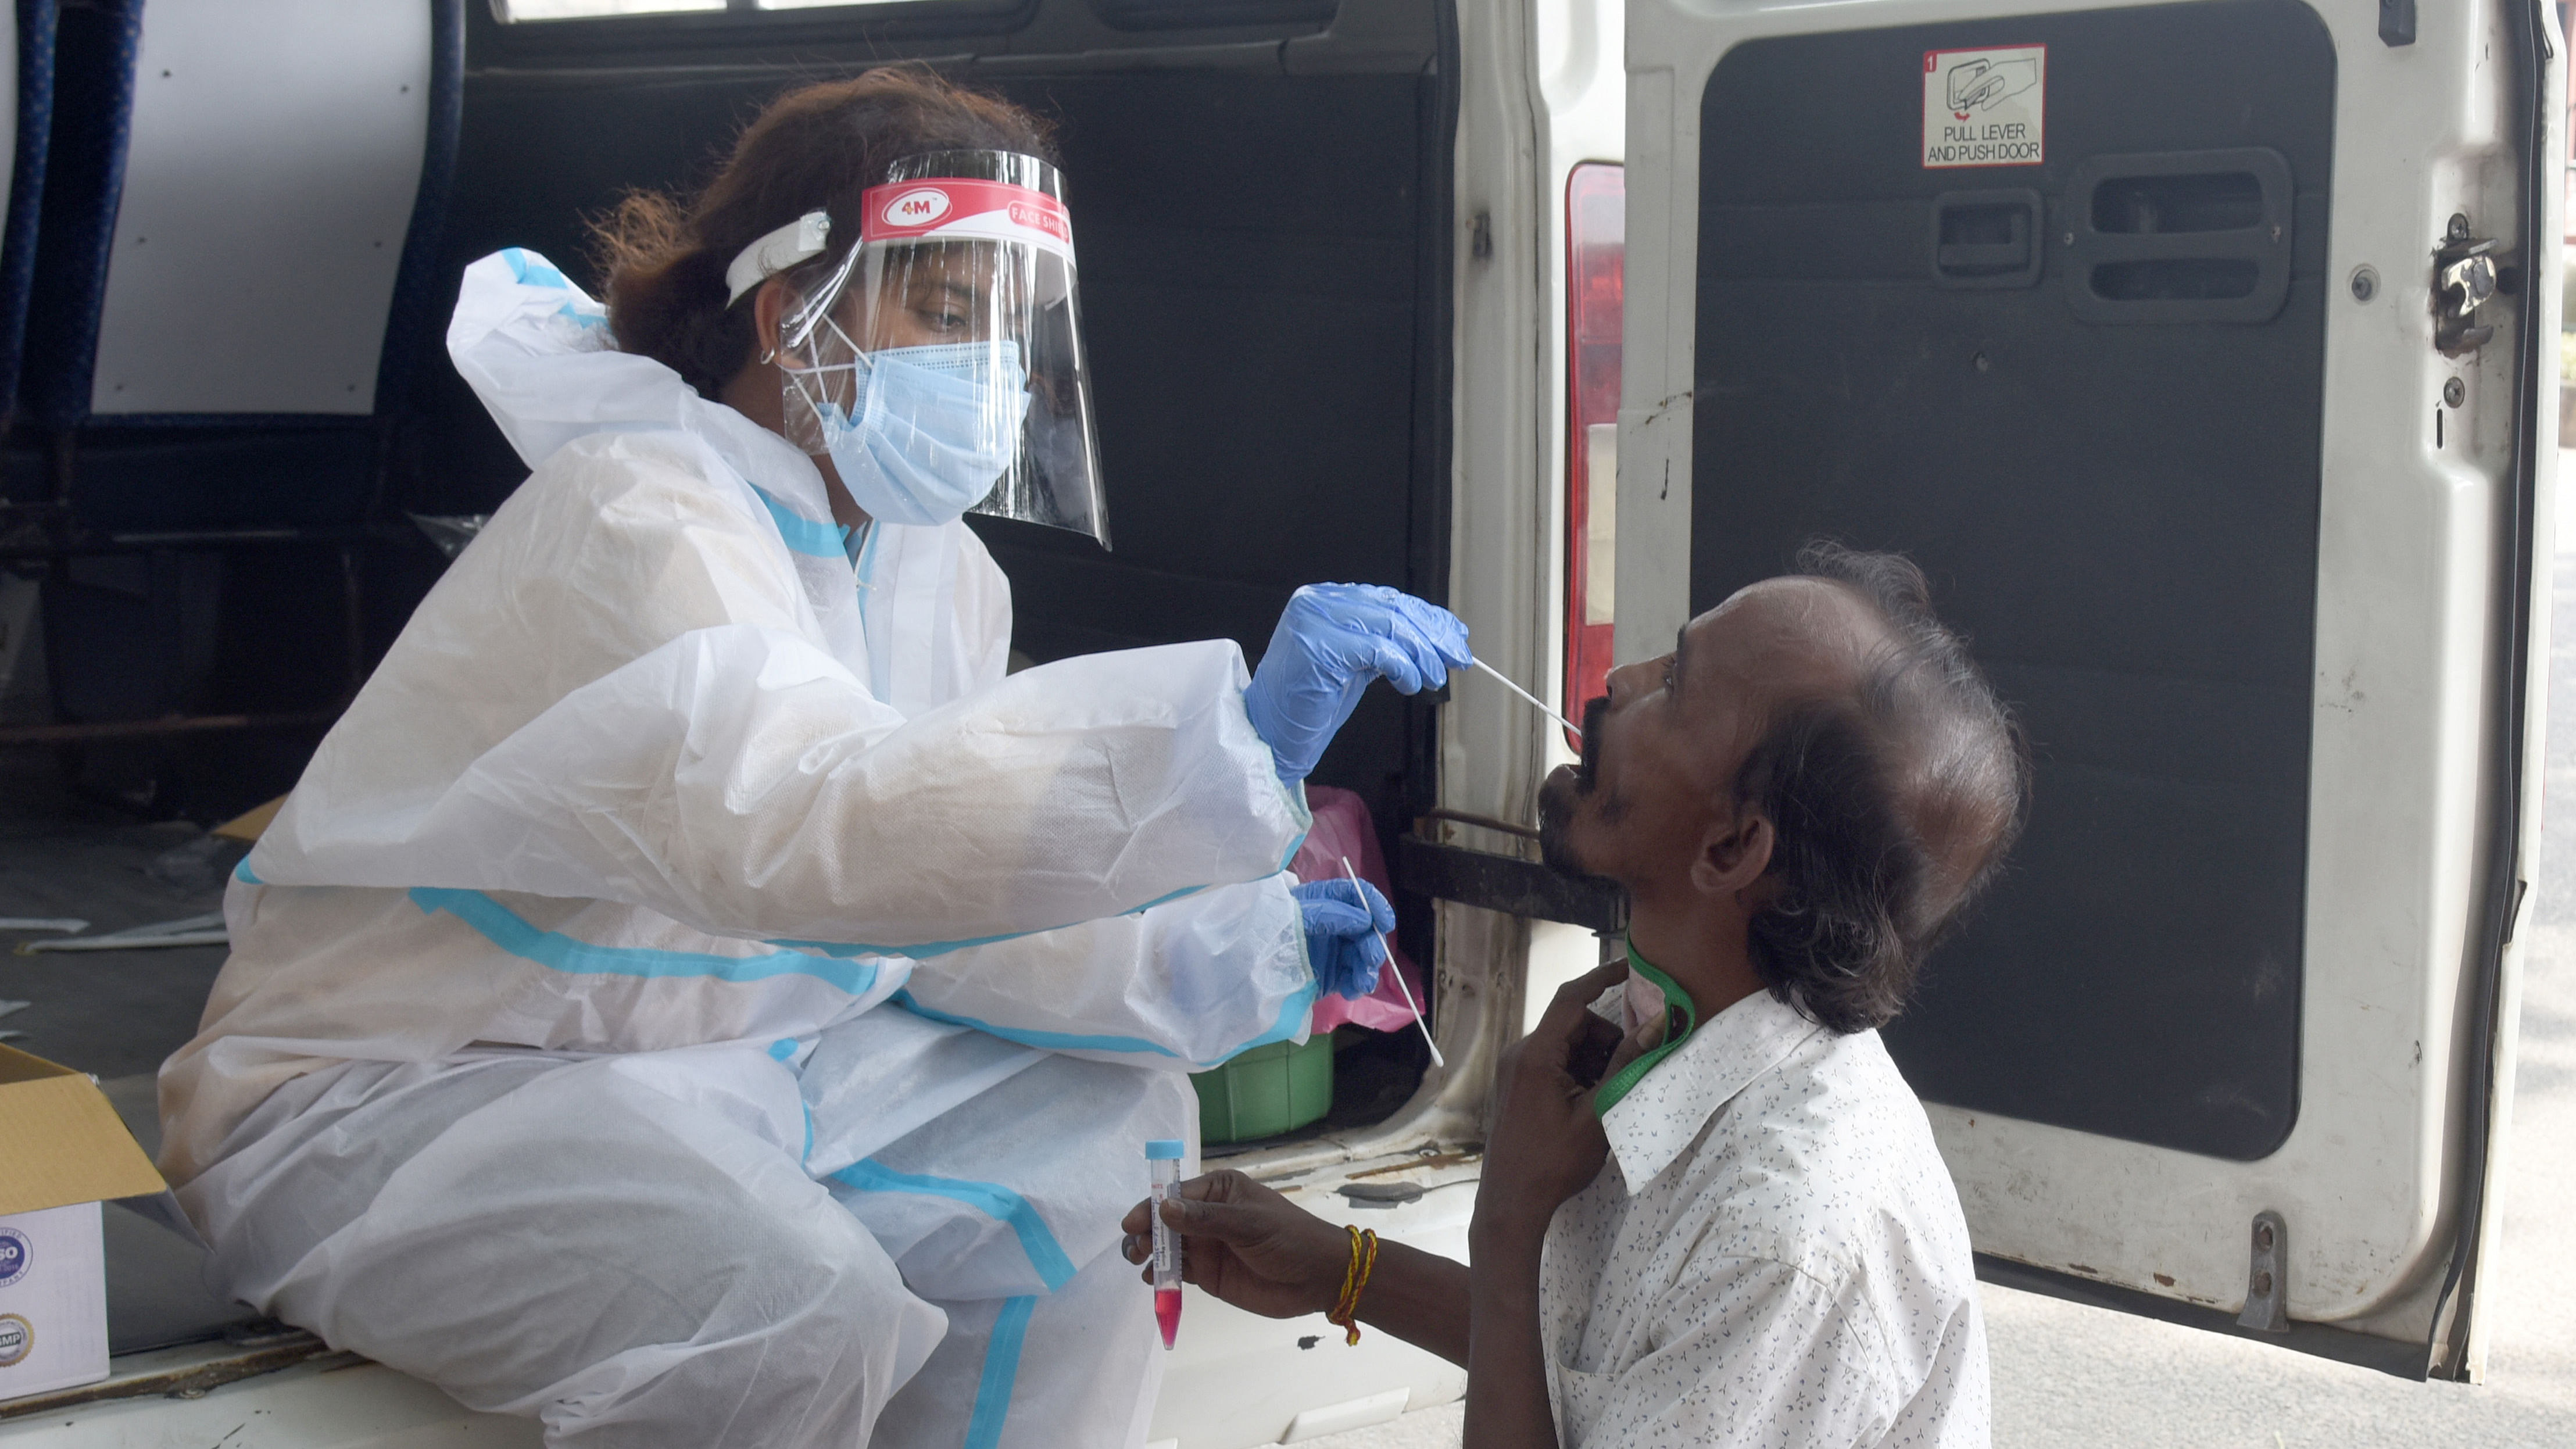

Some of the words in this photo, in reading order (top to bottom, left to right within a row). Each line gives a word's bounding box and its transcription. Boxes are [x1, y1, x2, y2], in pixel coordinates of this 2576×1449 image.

[1927, 55, 1933, 71] 1
[1944, 126, 1976, 142] PULL
[1982, 123, 2026, 140] LEVER
[1928, 146, 1956, 162] AND
[1959, 144, 1995, 161] PUSH
[1999, 142, 2040, 159] DOOR
[901, 201, 931, 215] 4M
[1012, 207, 1040, 225] FACE
[0, 1334, 20, 1346] MP
